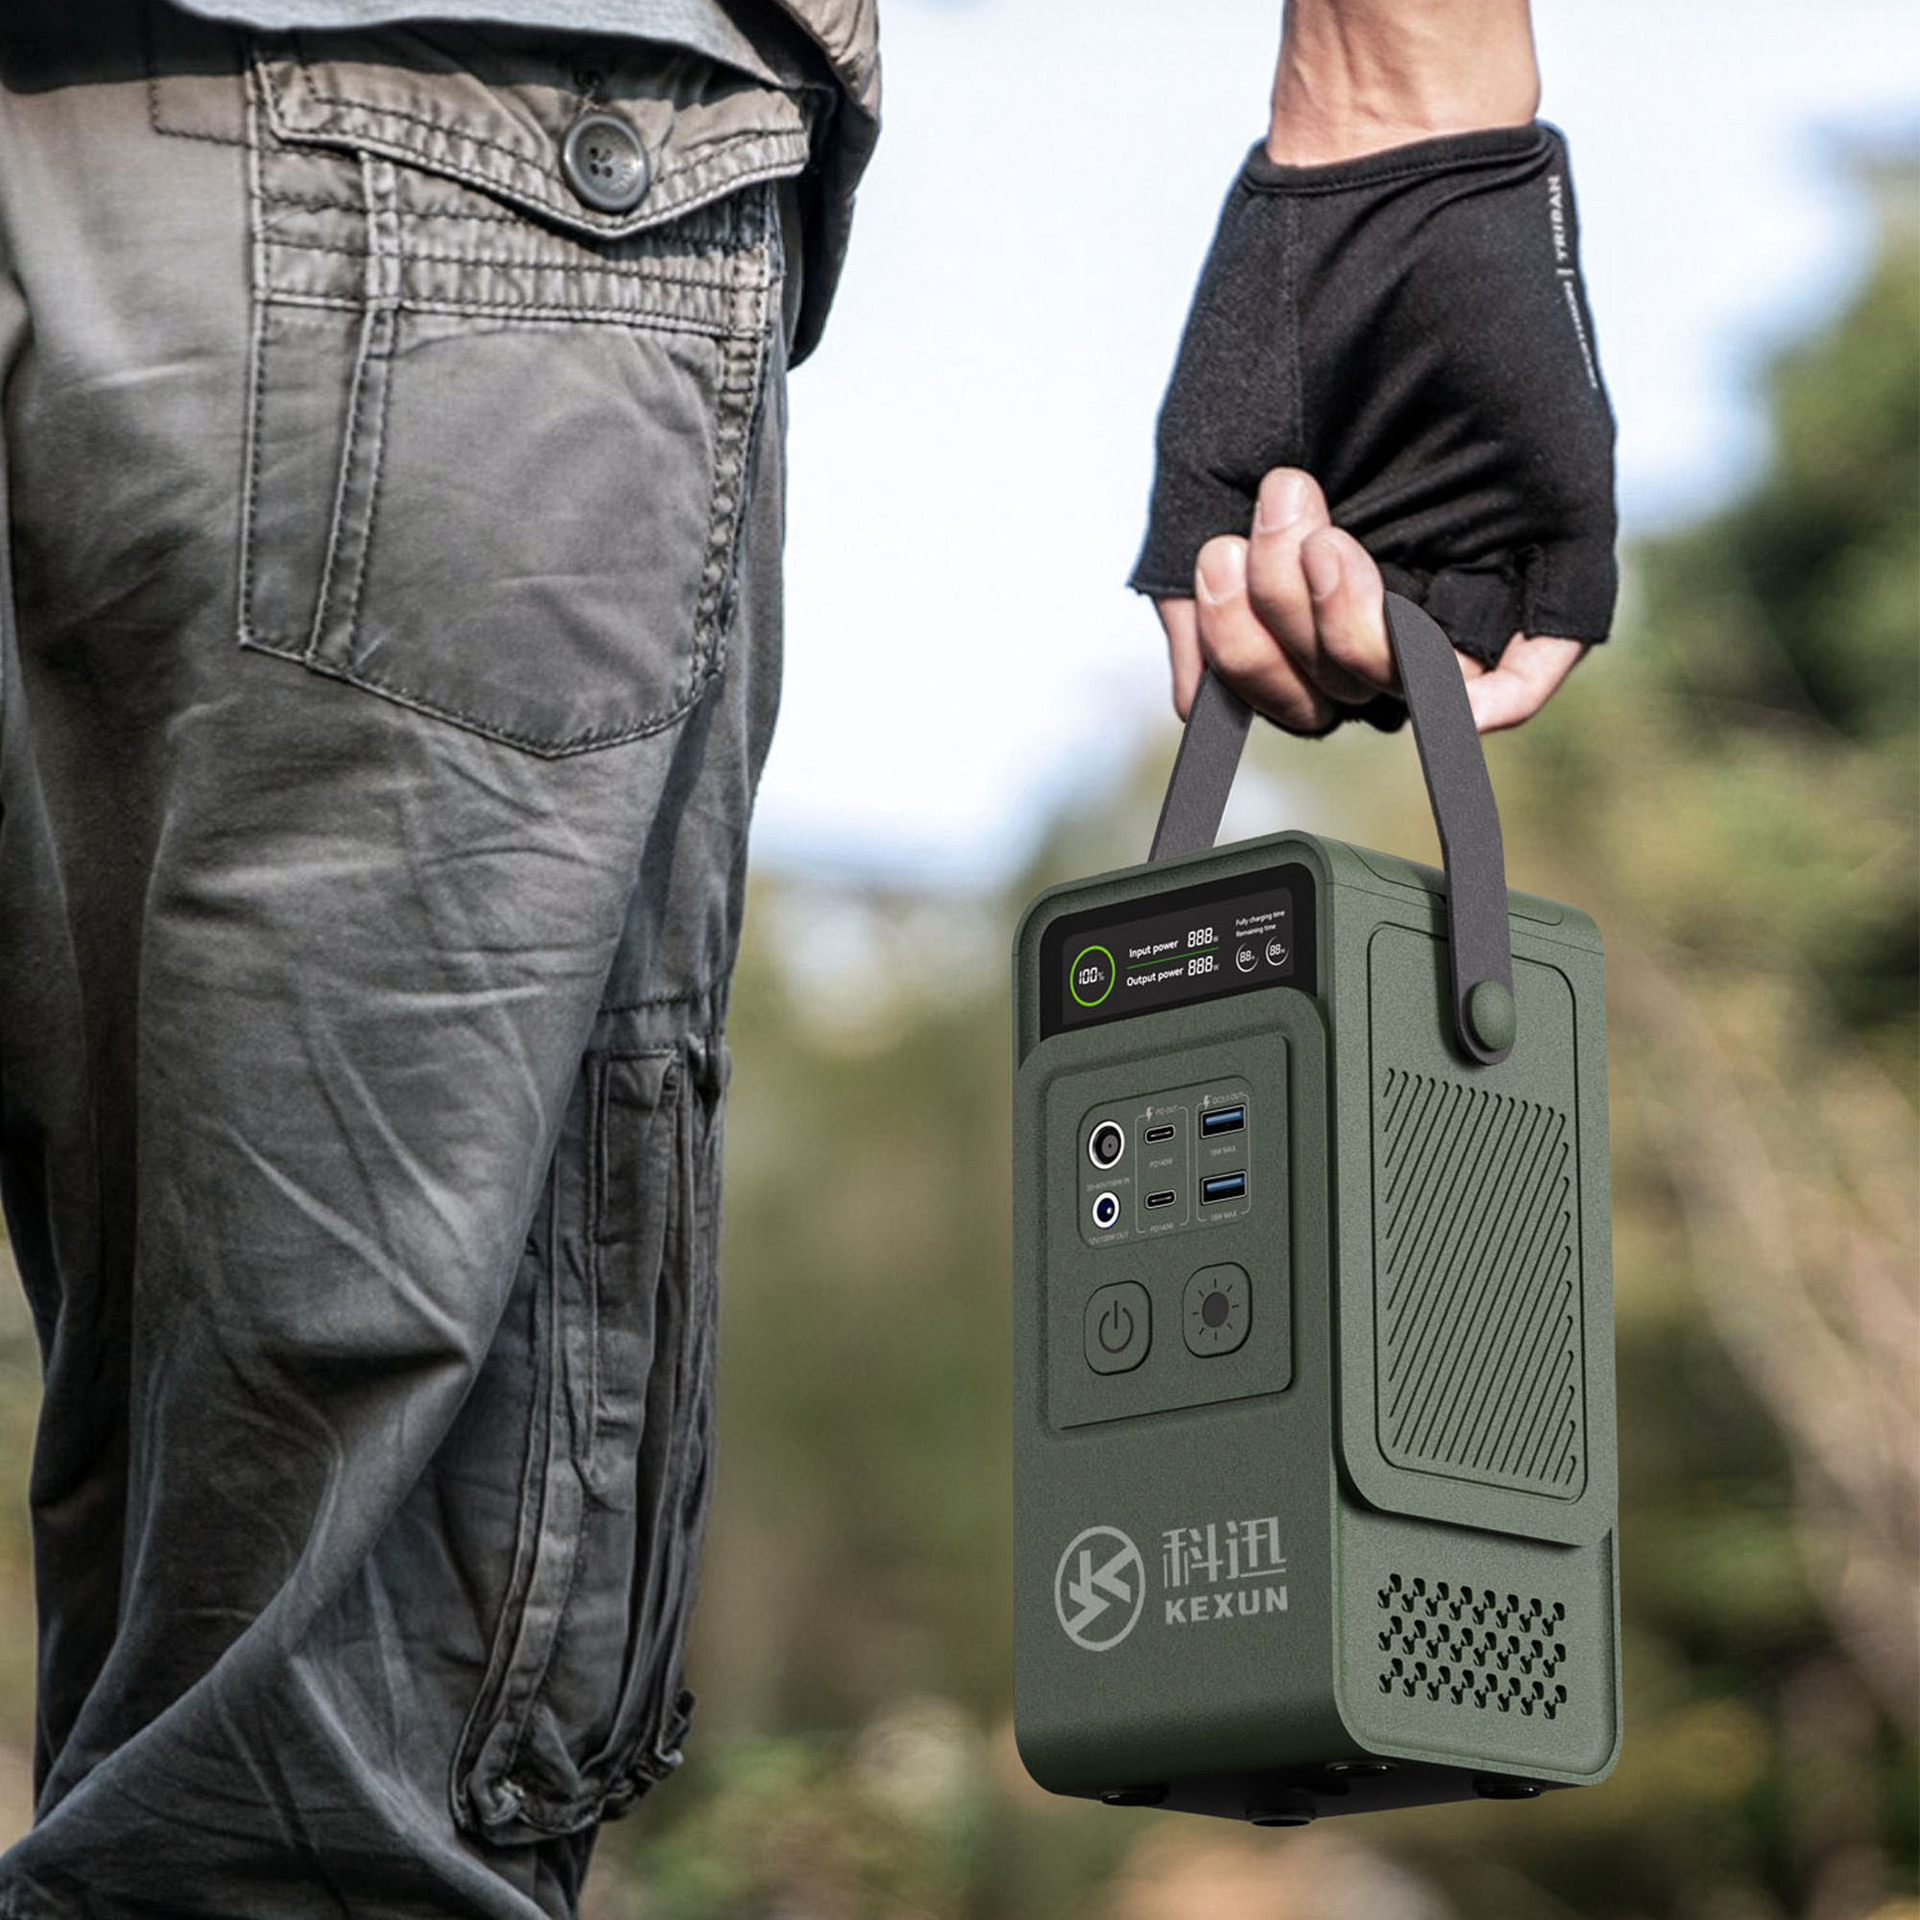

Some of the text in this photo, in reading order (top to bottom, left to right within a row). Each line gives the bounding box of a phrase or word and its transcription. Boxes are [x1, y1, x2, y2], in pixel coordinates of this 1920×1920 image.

[1235, 910, 1286, 927] Fully charging time
[1235, 923, 1277, 938] Remaining time
[1129, 945, 1151, 959] Input
[1153, 938, 1179, 955] power
[1126, 971, 1157, 987] Output
[1157, 966, 1184, 983] power
[1161, 1516, 1288, 1588] 科迅
[1165, 1585, 1289, 1626] KEXUN
